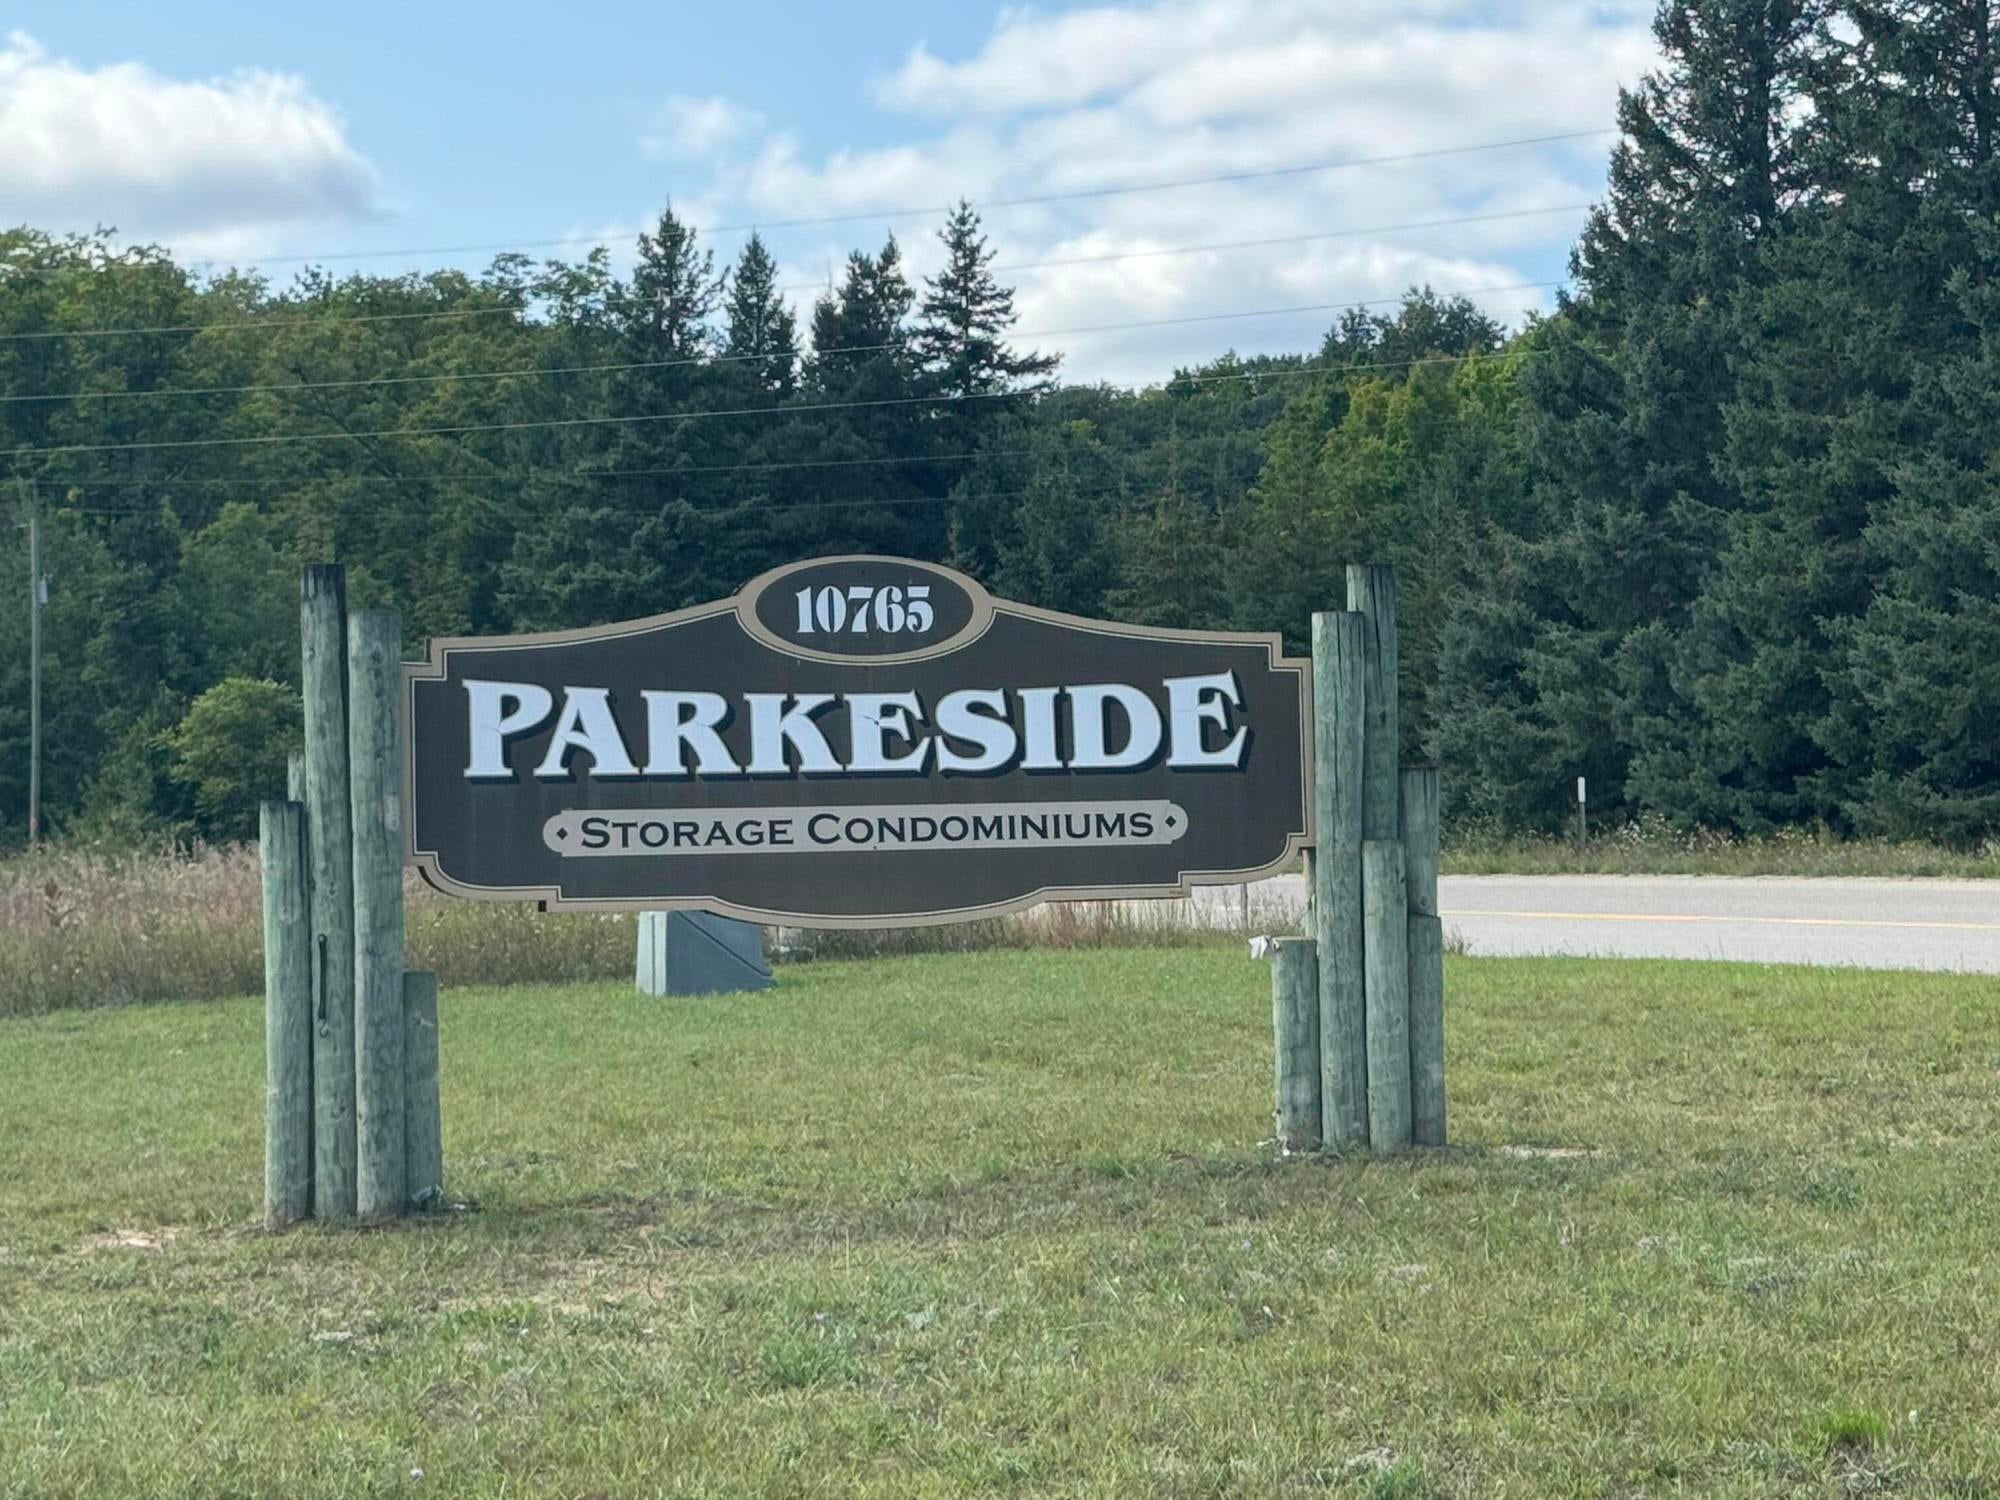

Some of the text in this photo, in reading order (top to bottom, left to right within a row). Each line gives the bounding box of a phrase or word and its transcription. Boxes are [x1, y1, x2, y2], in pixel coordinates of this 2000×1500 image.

[795, 585, 934, 633] 10765
[461, 669, 1248, 779] PARKESIDE
[581, 812, 1154, 849] STORAGE CONDOMINIUMS
